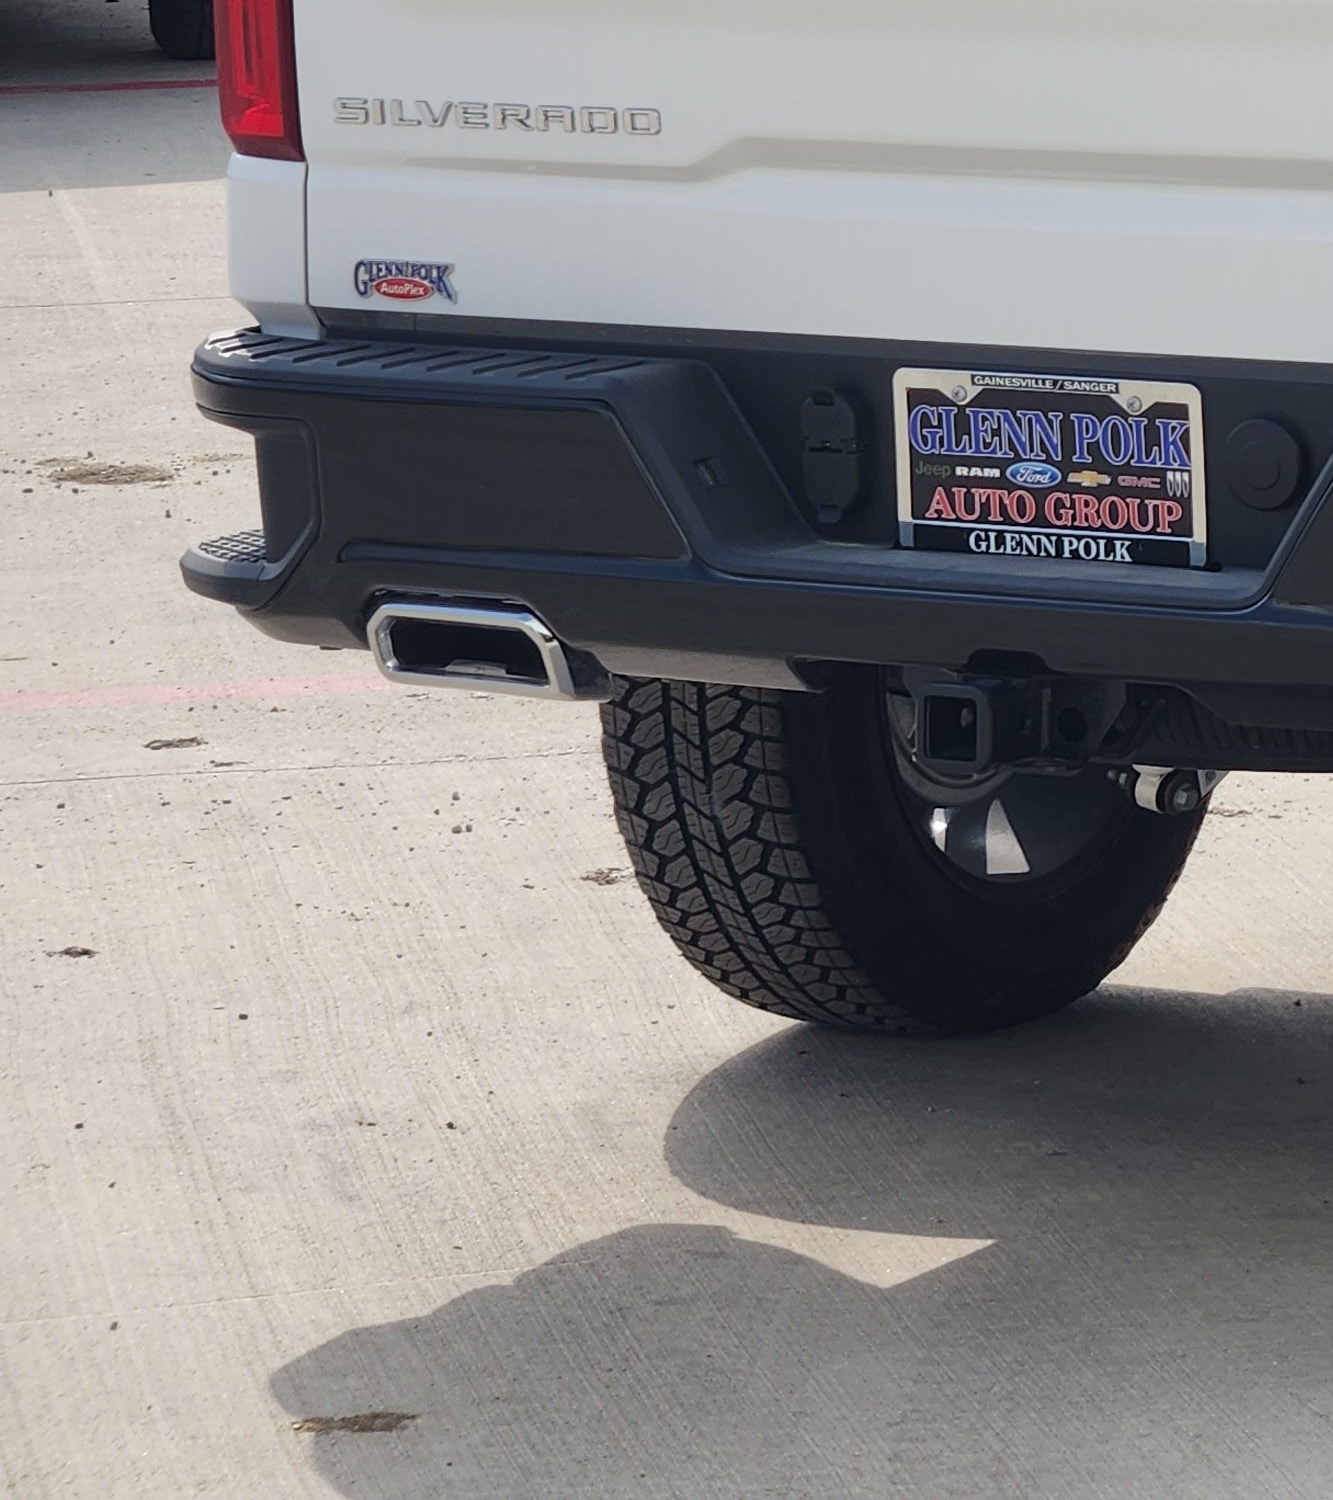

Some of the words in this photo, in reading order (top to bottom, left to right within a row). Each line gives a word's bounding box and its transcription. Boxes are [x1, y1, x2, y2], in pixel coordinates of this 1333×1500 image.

[333, 97, 662, 136] SILVERADO
[354, 260, 403, 296] GLENN
[411, 263, 452, 300] POLK
[909, 404, 1063, 461] GLENN
[1070, 413, 1191, 469] POLK
[915, 460, 950, 478] Jeep
[955, 466, 1001, 477] RAM
[1016, 464, 1051, 484] Ford
[1118, 475, 1162, 489] GMC
[925, 486, 1036, 524] AUTO
[1044, 492, 1183, 533] GROUP
[968, 530, 1058, 557] GLENN
[1061, 536, 1133, 563] POLK
